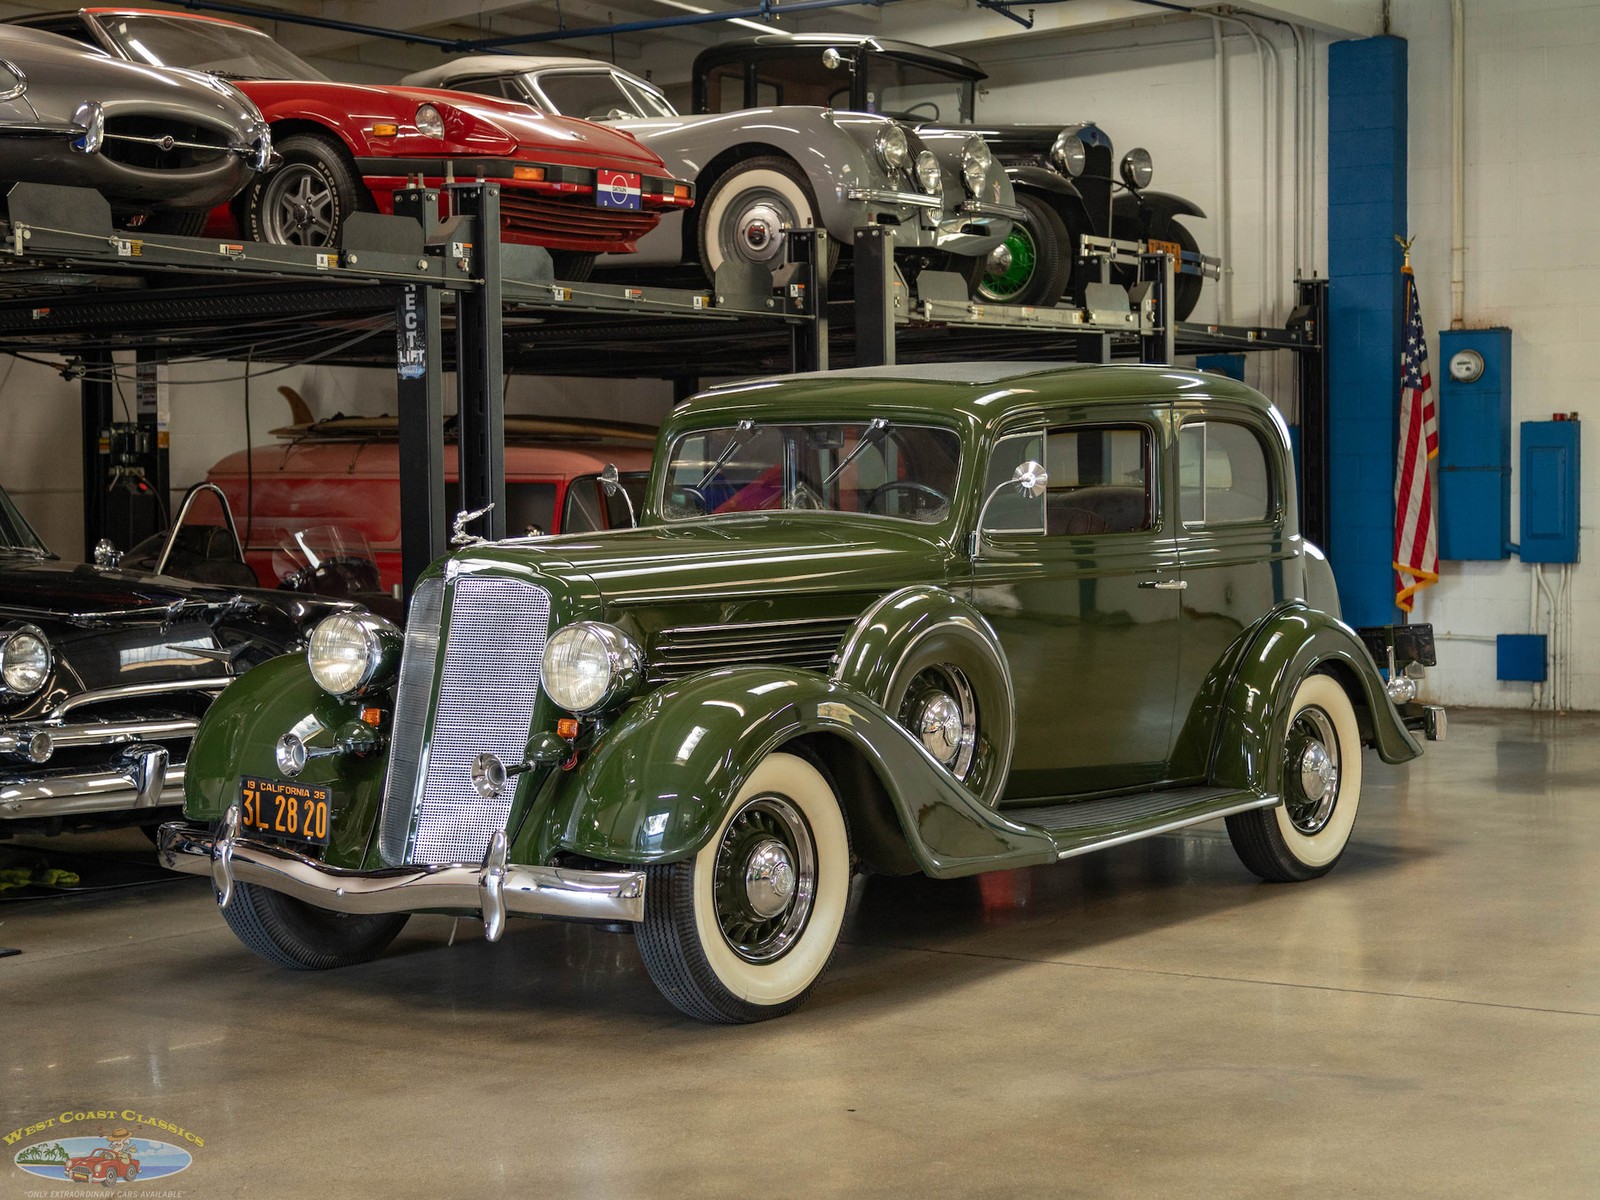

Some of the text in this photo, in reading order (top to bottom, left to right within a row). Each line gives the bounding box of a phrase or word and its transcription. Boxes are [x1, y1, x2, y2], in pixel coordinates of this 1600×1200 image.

[250, 184, 261, 242] dial T/A
[399, 349, 425, 363] LIFT
[247, 781, 326, 800] 19 CALIFORNIA 35
[243, 789, 327, 839] 3L 28 20
